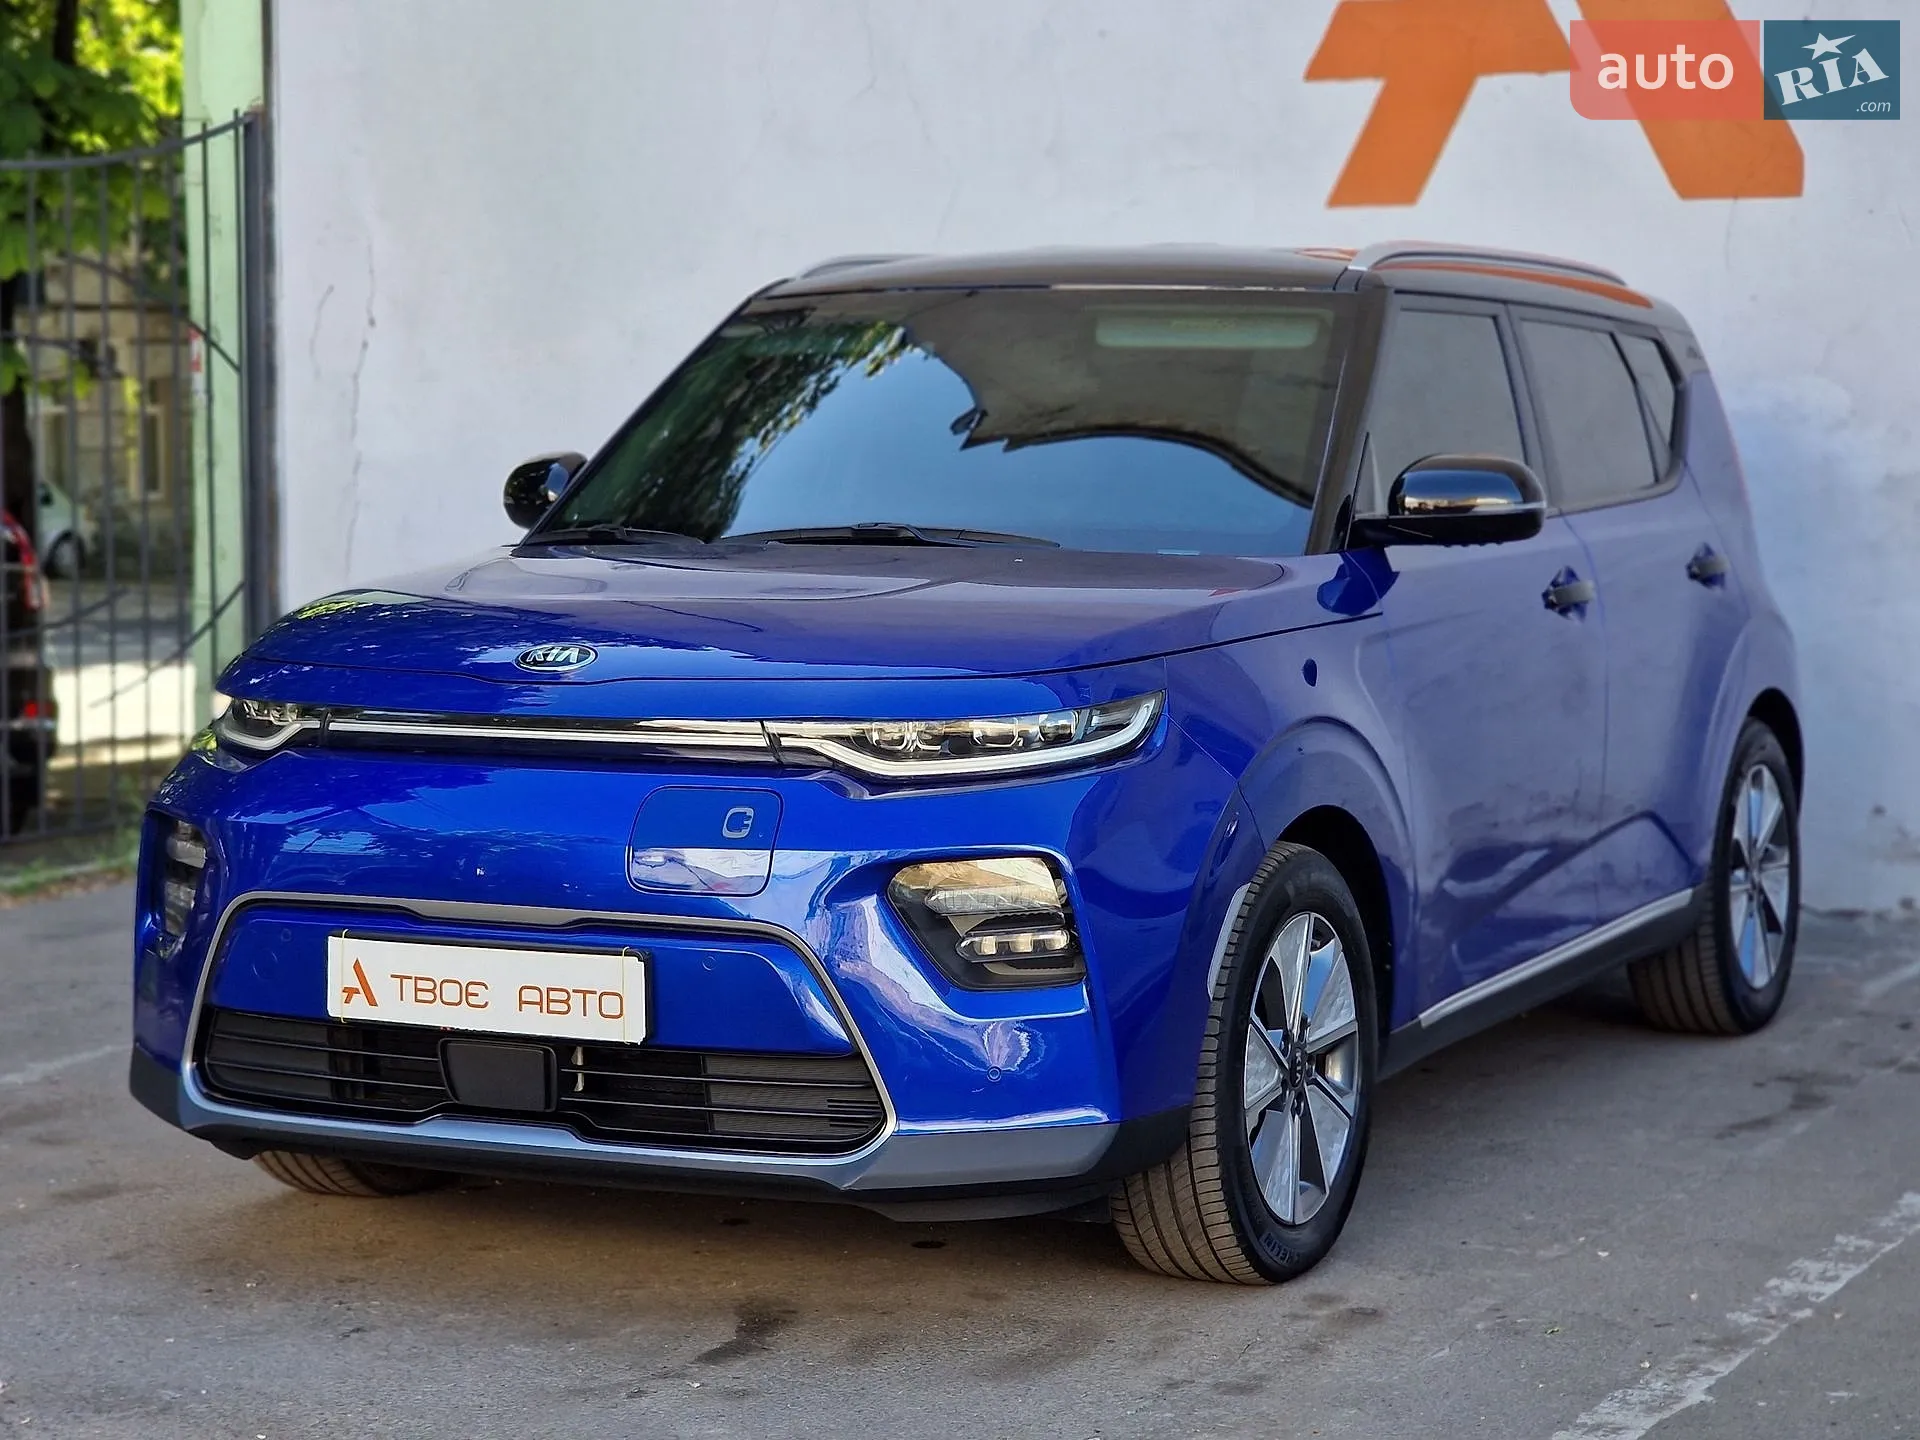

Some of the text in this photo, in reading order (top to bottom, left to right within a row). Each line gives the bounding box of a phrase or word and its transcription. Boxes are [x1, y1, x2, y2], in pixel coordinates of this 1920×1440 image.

[526, 647, 580, 664] KIA
[390, 974, 490, 1009] ТВОЄ
[518, 985, 625, 1020] АВТО
